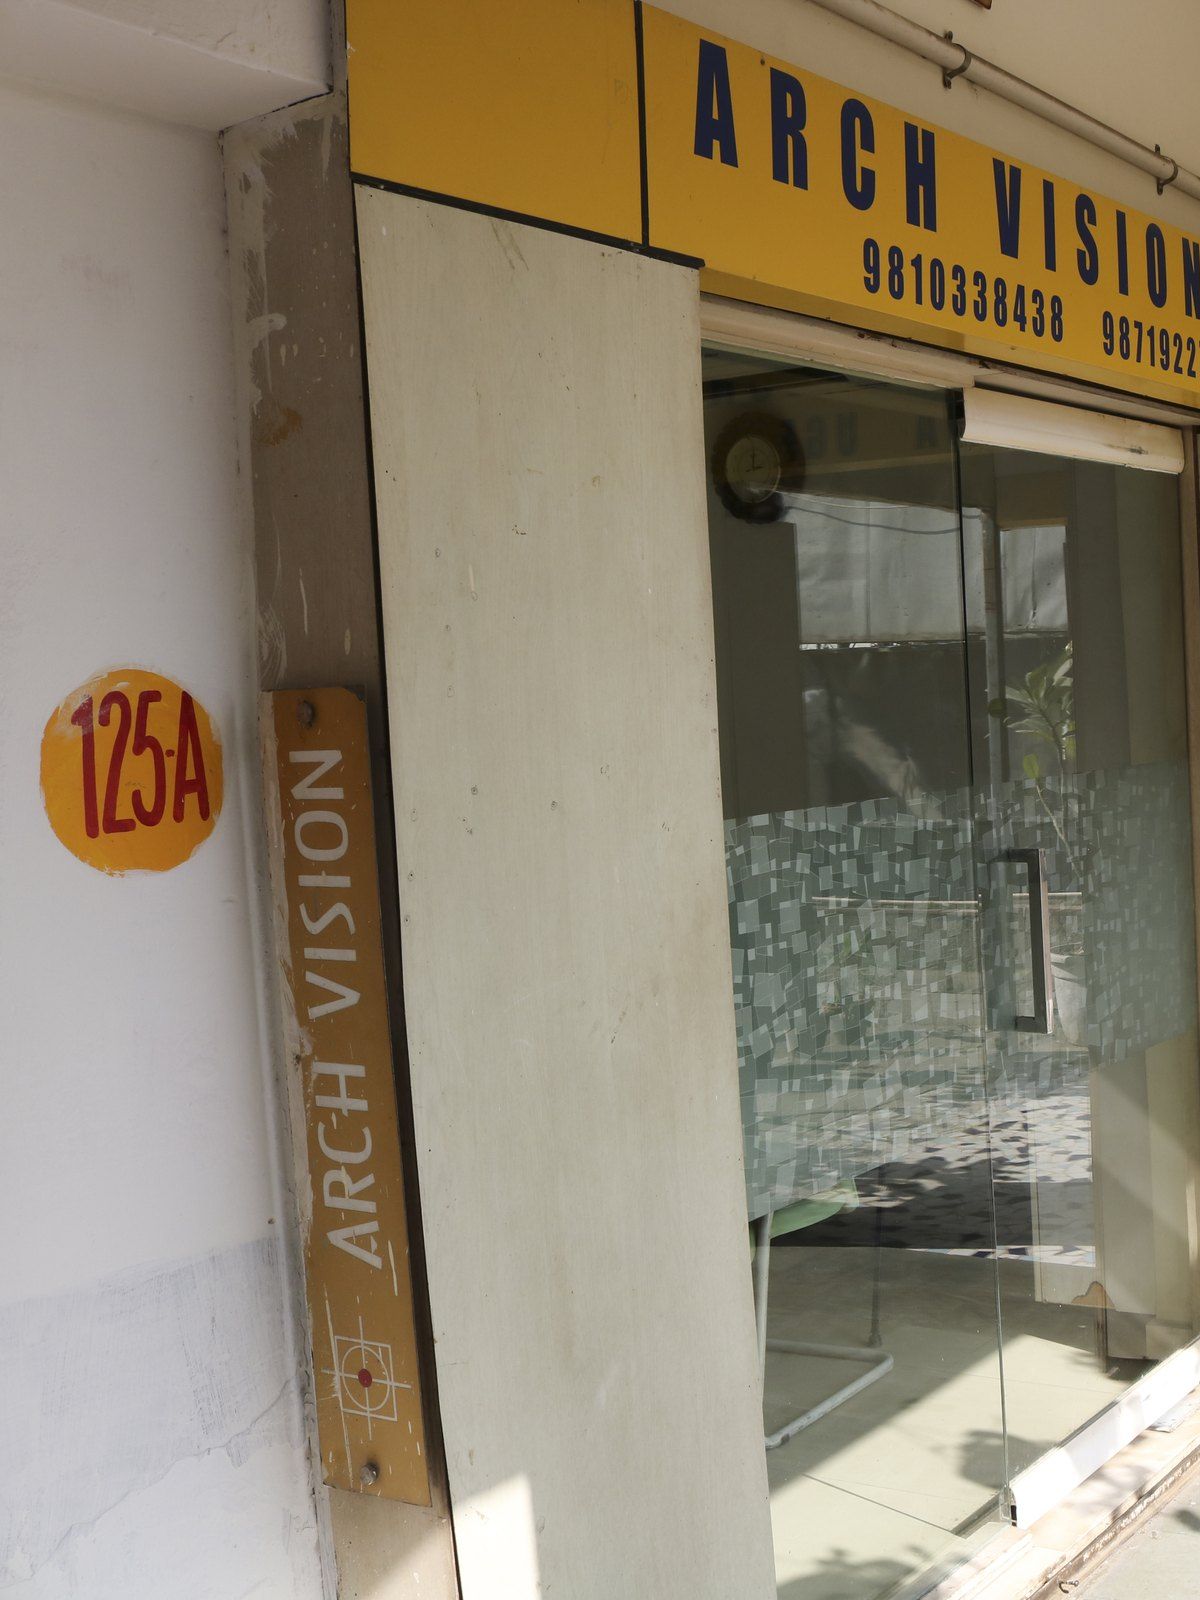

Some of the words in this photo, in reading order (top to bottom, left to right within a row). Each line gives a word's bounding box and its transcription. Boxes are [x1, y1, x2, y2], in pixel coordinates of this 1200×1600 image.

[693, 38, 938, 232] ARCH
[862, 237, 1065, 342] 9810338438
[288, 749, 361, 1021] VISION
[314, 1060, 383, 1272] ARCH
